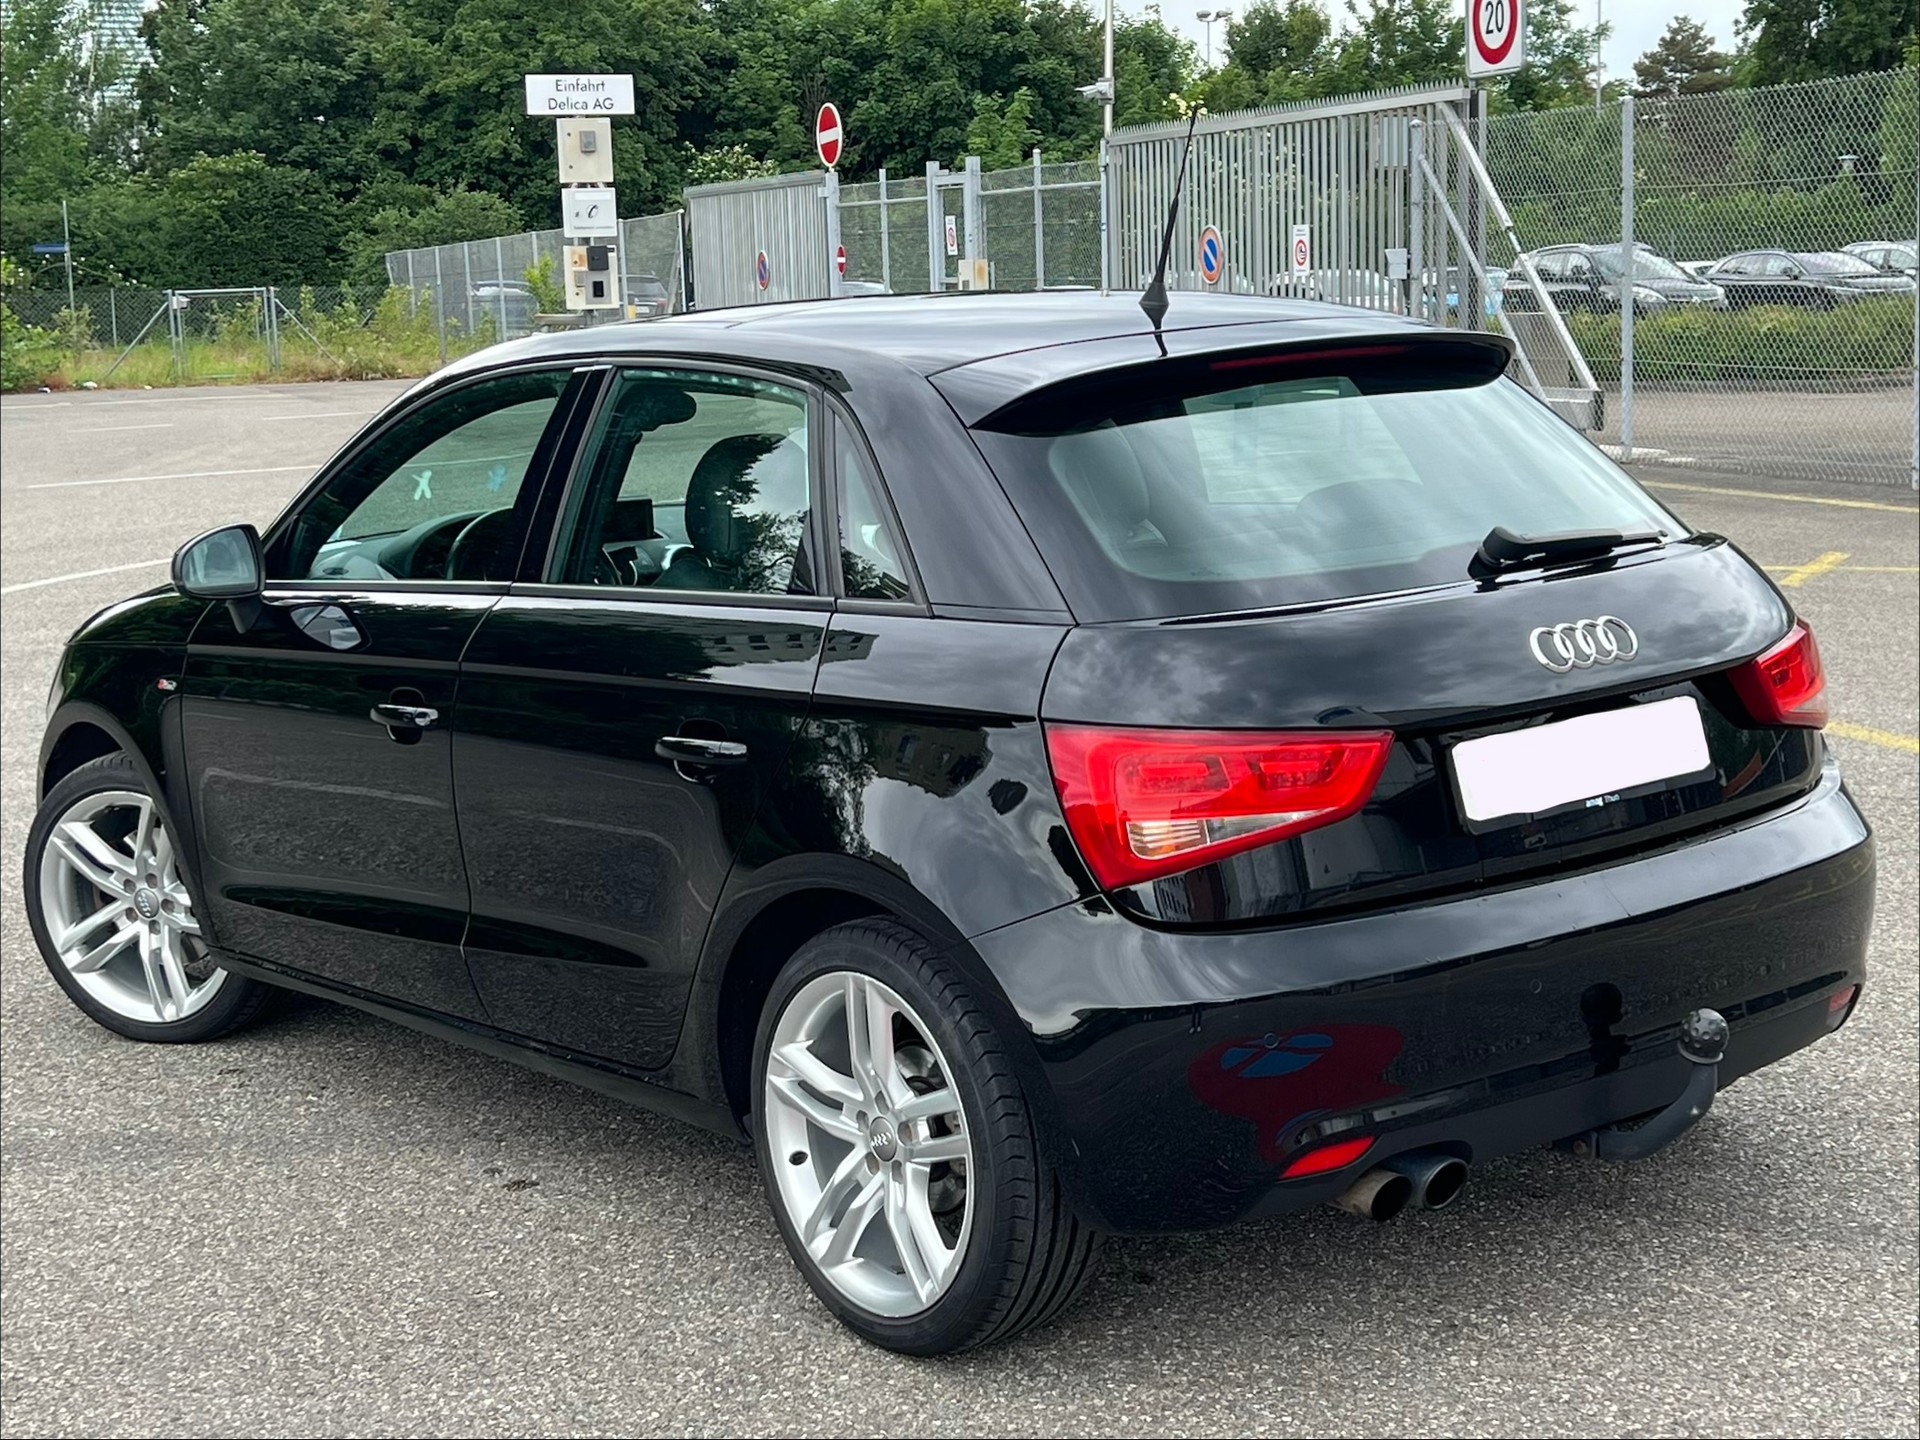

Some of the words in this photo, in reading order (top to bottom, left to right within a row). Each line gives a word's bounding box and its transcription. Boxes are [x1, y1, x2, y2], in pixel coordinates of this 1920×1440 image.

[1485, 0, 1504, 34] 20
[555, 78, 605, 92] Einfahrt
[548, 97, 588, 110] Delica
[593, 97, 614, 110] AG
